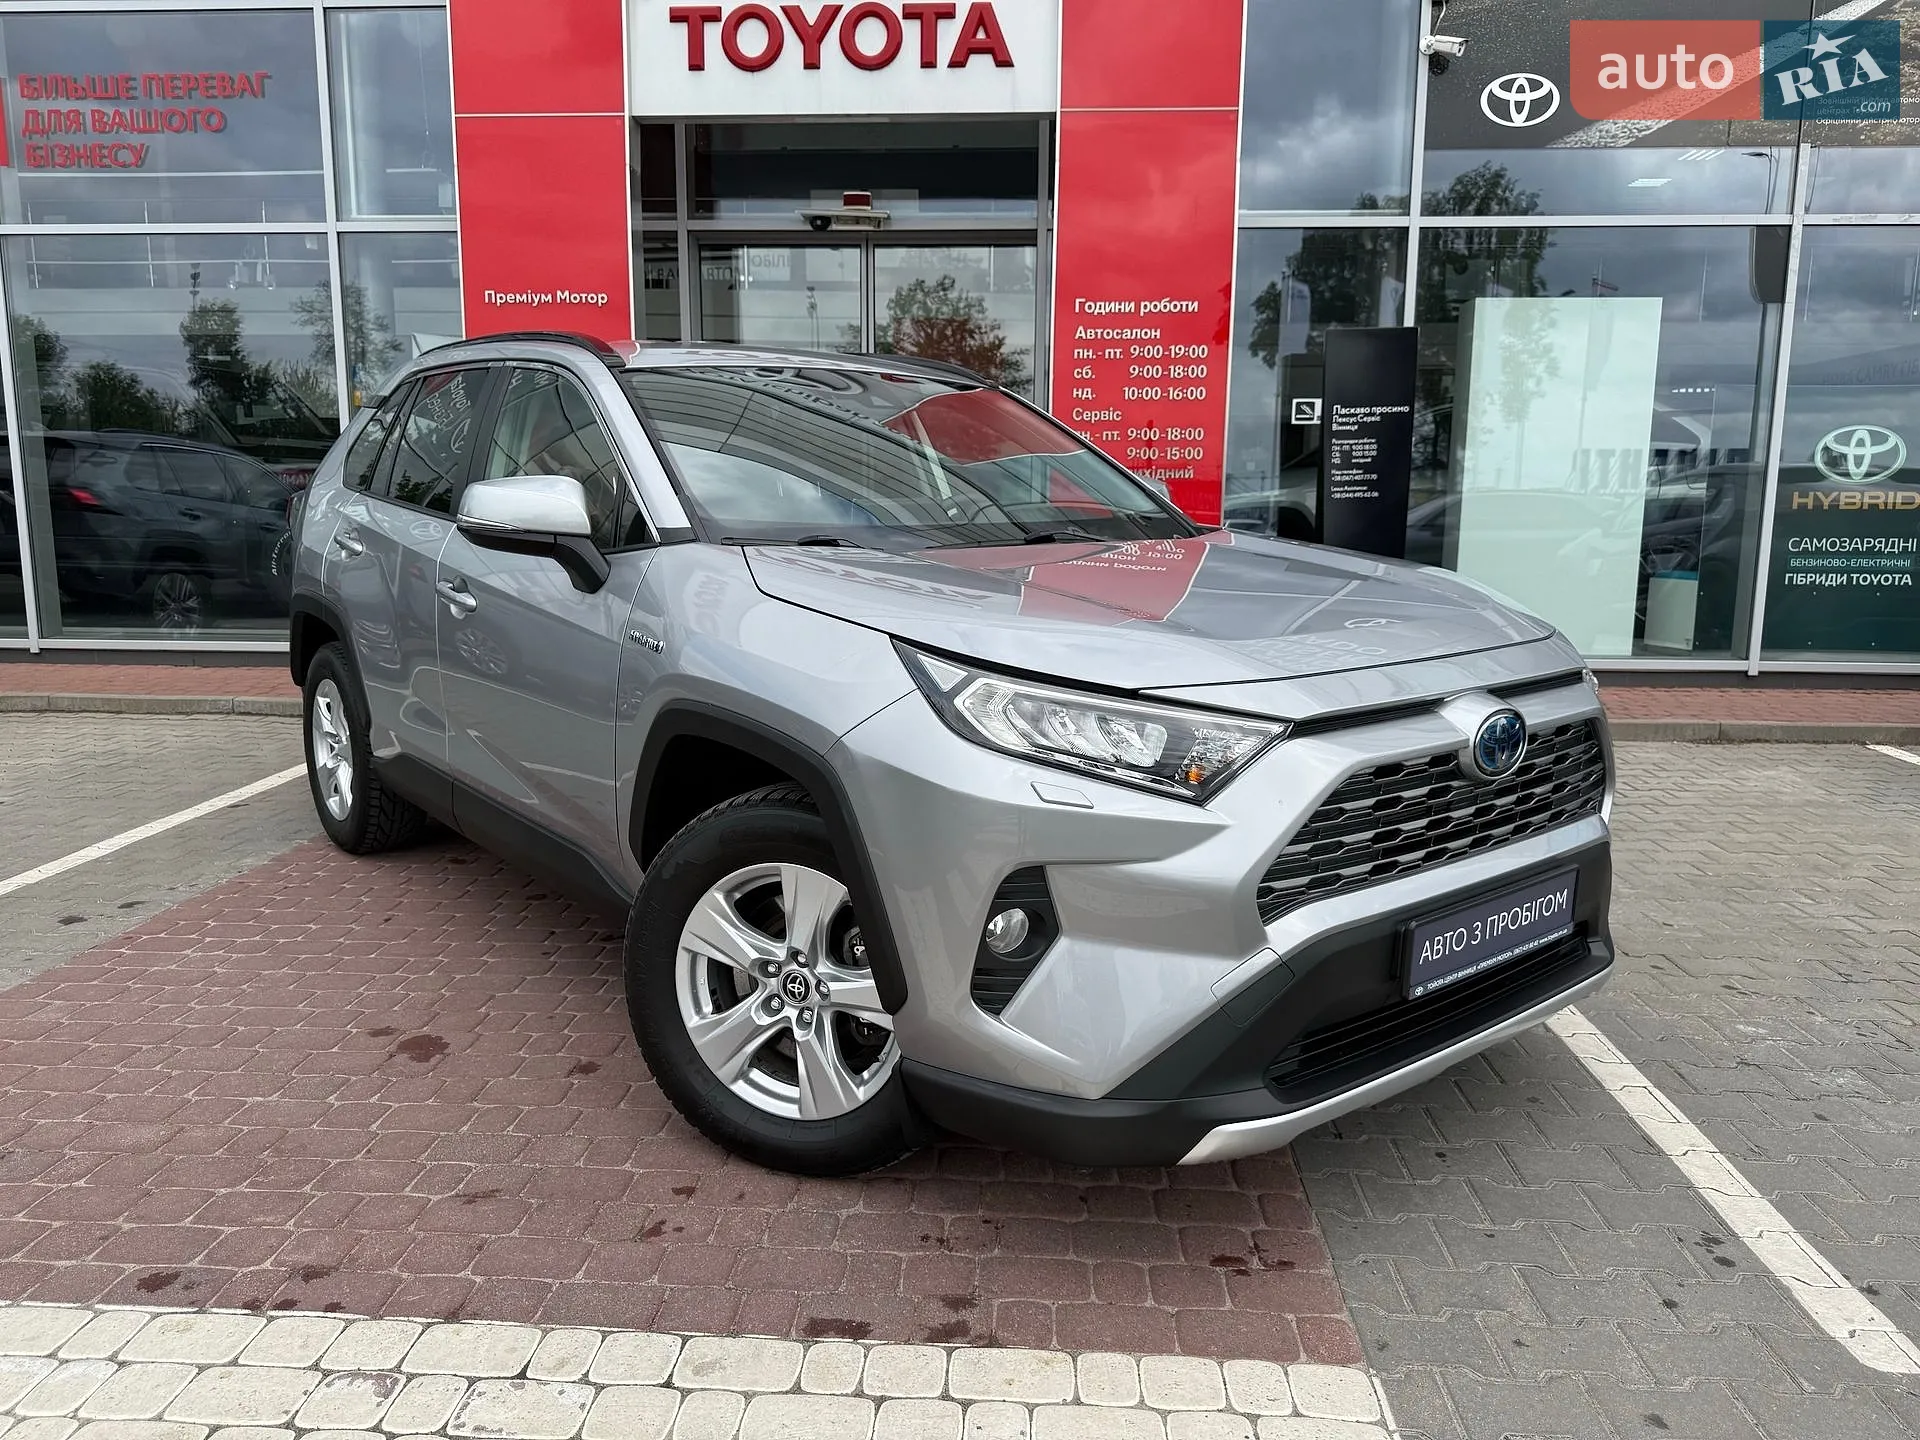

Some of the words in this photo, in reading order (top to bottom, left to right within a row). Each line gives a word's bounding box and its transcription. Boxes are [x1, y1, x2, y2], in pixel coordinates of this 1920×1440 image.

[669, 1, 1015, 72] TOYOTA
[17, 73, 138, 100] БІЛЬШЕ
[140, 70, 271, 98] ПЕРЕВАГ
[21, 108, 82, 138] ДЛЯ
[90, 106, 226, 135] ВАШОГО
[25, 142, 147, 169] БІЗНЕСУ
[484, 289, 553, 307] Преміум
[556, 289, 609, 307] Мотор
[1074, 297, 1136, 316] Години
[1139, 297, 1199, 317] роботи
[1074, 325, 1161, 340] Автосалон
[1129, 344, 1209, 359] 9:00-19:00
[1073, 365, 1096, 379] сб.
[1128, 364, 1208, 379] 9:00-18:00
[1072, 387, 1097, 400] нд.
[1122, 386, 1207, 401] 10:00-16:00
[1072, 407, 1123, 423] Сервіс
[1332, 404, 1371, 415] Ласкаво
[1371, 405, 1410, 415] просимо
[1127, 427, 1205, 441] 9:00-18:00
[1126, 446, 1204, 460] 9:00-15:00
[1791, 491, 1920, 510] HYBRID
[1788, 537, 1917, 554] САМОЗАРЯДНІ
[1790, 558, 1911, 567] БЕНЗИНОВО-ЕЛЕКТРИЧНІ
[1785, 573, 1847, 587] ГІБРИДИ
[1850, 573, 1912, 586] TOYOTA
[1418, 927, 1467, 965] АВТО
[1485, 888, 1568, 940] ПРОБІГОМ
